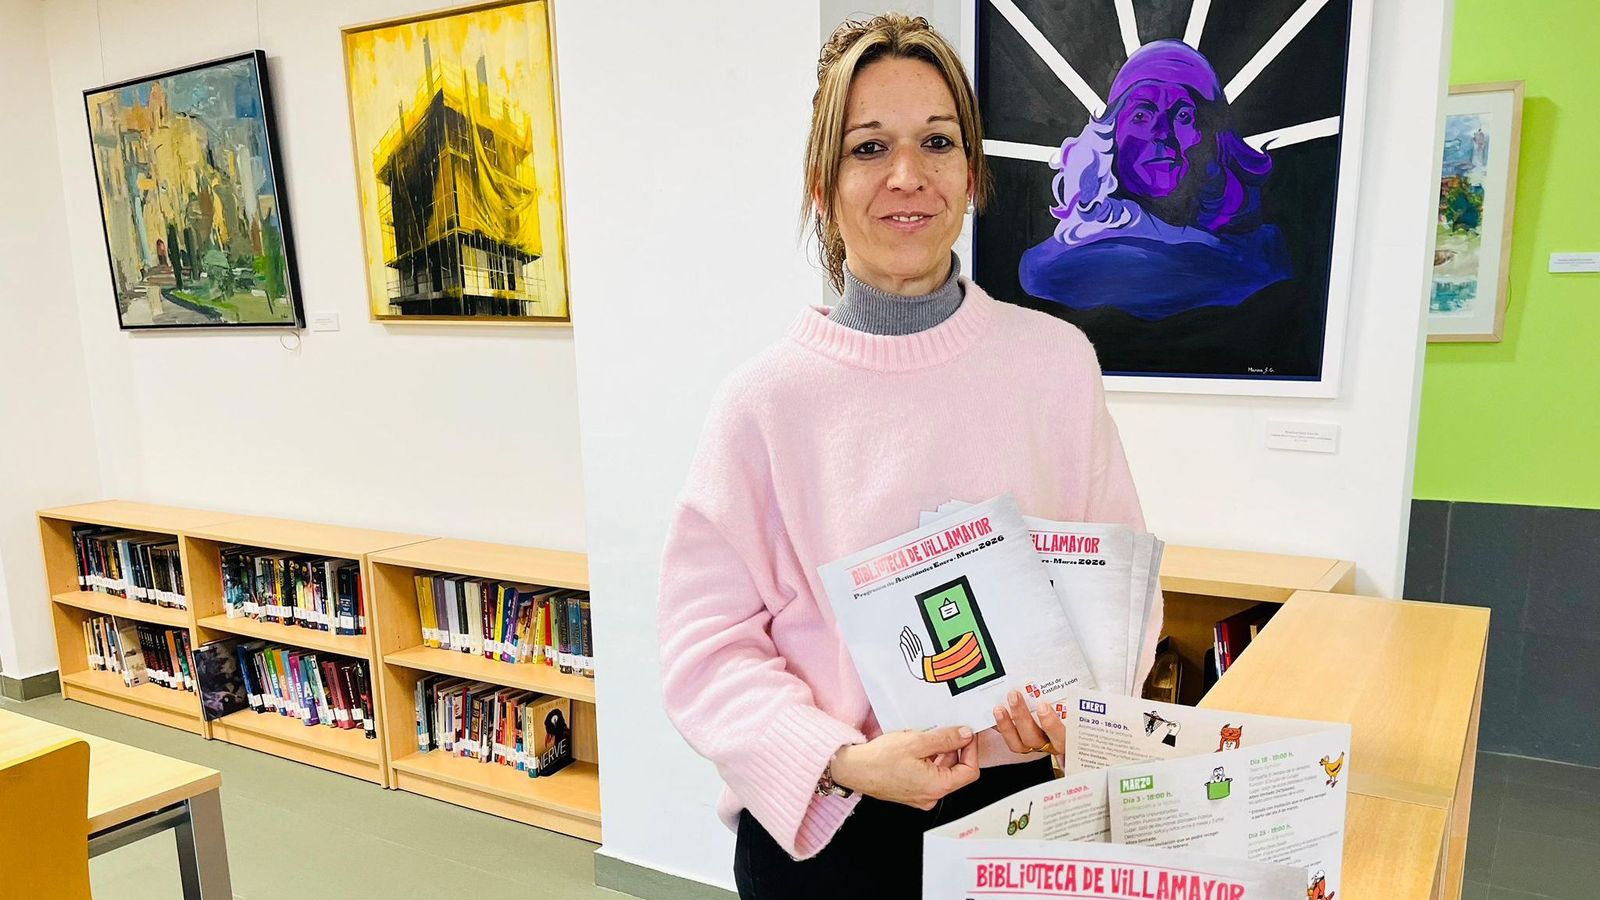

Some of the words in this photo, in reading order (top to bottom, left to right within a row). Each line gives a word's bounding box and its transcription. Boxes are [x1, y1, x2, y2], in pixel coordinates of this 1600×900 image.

[895, 565, 933, 584] Actividades
[933, 558, 953, 569] Enero
[956, 548, 979, 559] Marzo
[978, 535, 1005, 550] 2026
[906, 545, 922, 563] DE
[1040, 681, 1054, 690] Junta
[1042, 685, 1060, 695] Castilla
[1065, 677, 1079, 686] León
[1081, 700, 1105, 713] ENERO
[1105, 721, 1121, 729] 18:00
[537, 738, 567, 772] NERVE
[1122, 777, 1151, 792] MARZO
[1147, 793, 1164, 801] 18:00
[1083, 866, 1104, 893] DE
